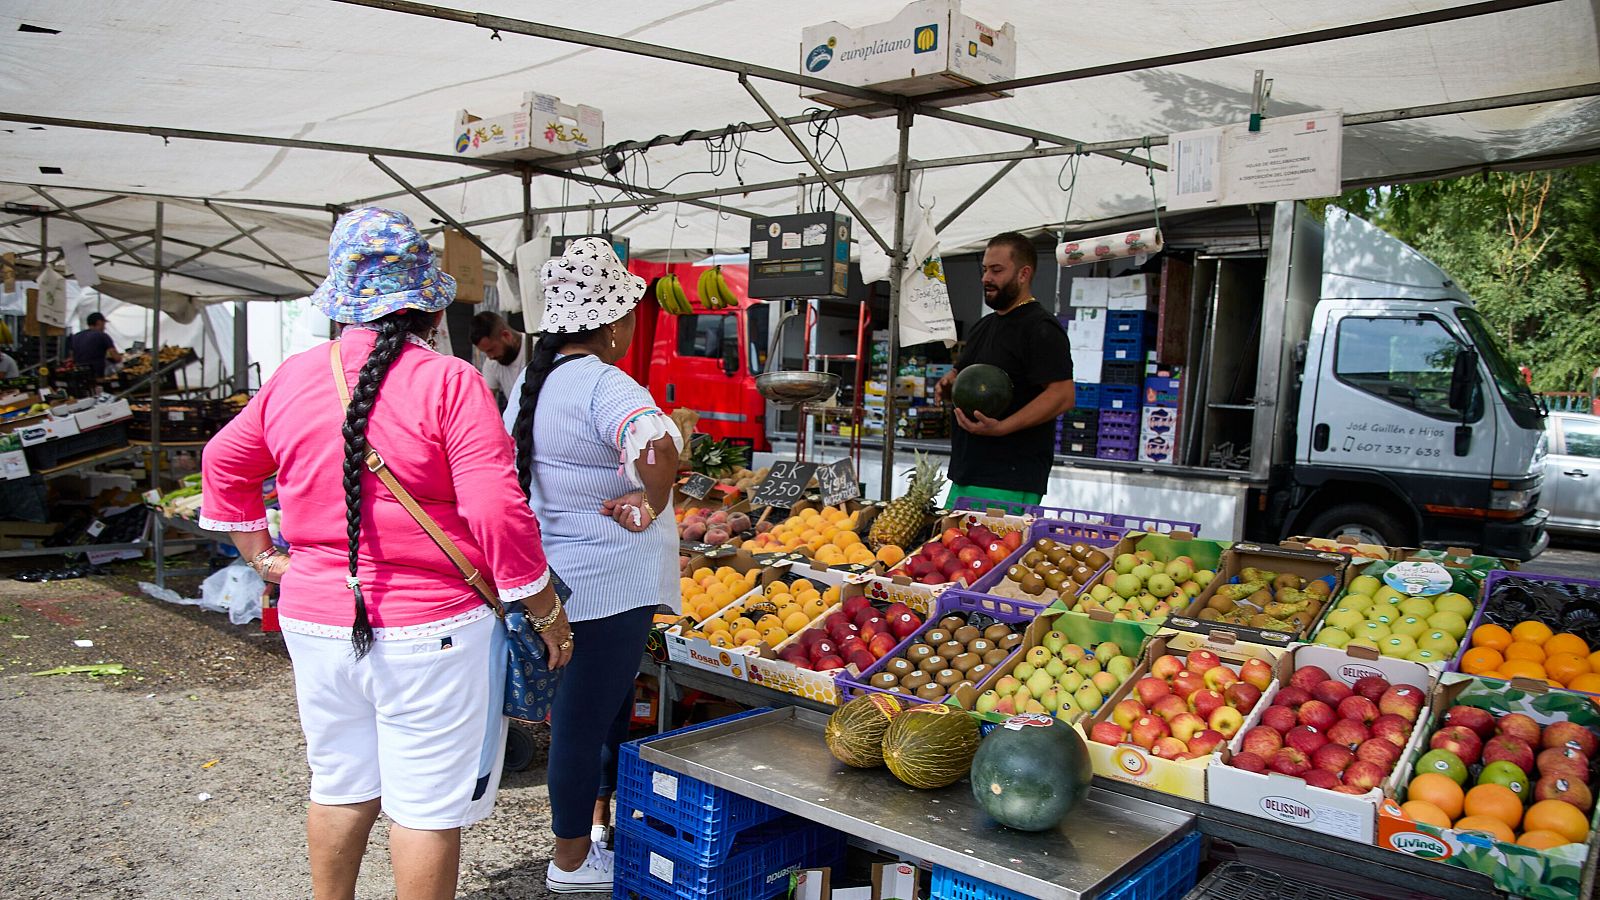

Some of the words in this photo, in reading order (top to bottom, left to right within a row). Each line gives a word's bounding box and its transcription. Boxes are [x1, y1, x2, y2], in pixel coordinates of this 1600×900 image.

[840, 38, 911, 61] europlátano
[1346, 422, 1367, 432] José
[1371, 423, 1406, 434] Guillén
[1409, 427, 1415, 435] e
[1418, 426, 1444, 439] Hijos
[1356, 443, 1382, 452] 607
[1385, 445, 1411, 455] 337
[1415, 447, 1441, 457] 638
[761, 480, 801, 496] 3,50
[690, 648, 720, 667] Rosan
[1265, 798, 1310, 819] DELISSIUM
